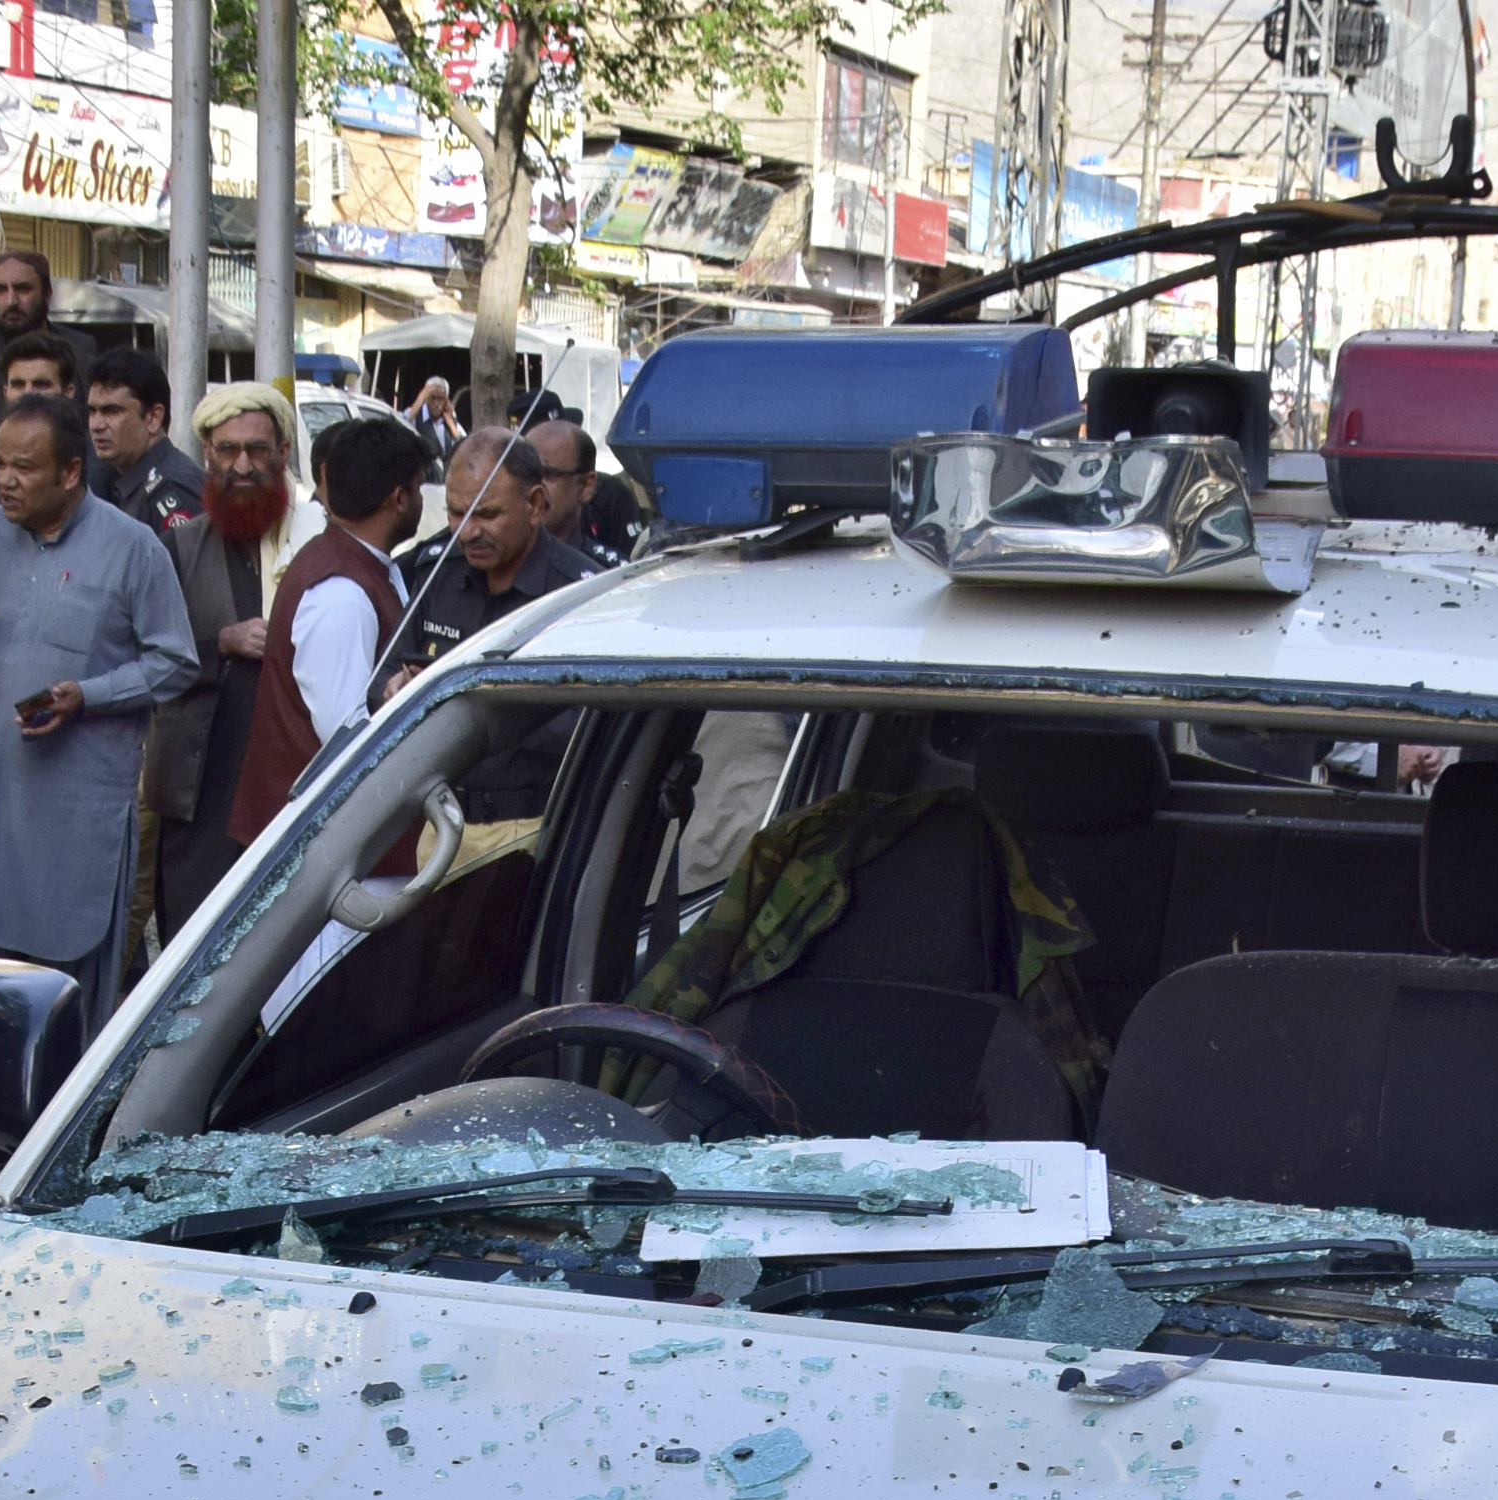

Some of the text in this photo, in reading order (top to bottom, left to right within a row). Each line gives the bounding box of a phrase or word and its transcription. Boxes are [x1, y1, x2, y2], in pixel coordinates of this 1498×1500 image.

[69, 100, 97, 122] Bata
[22, 131, 78, 198] Wen
[83, 138, 153, 207] Shoes
